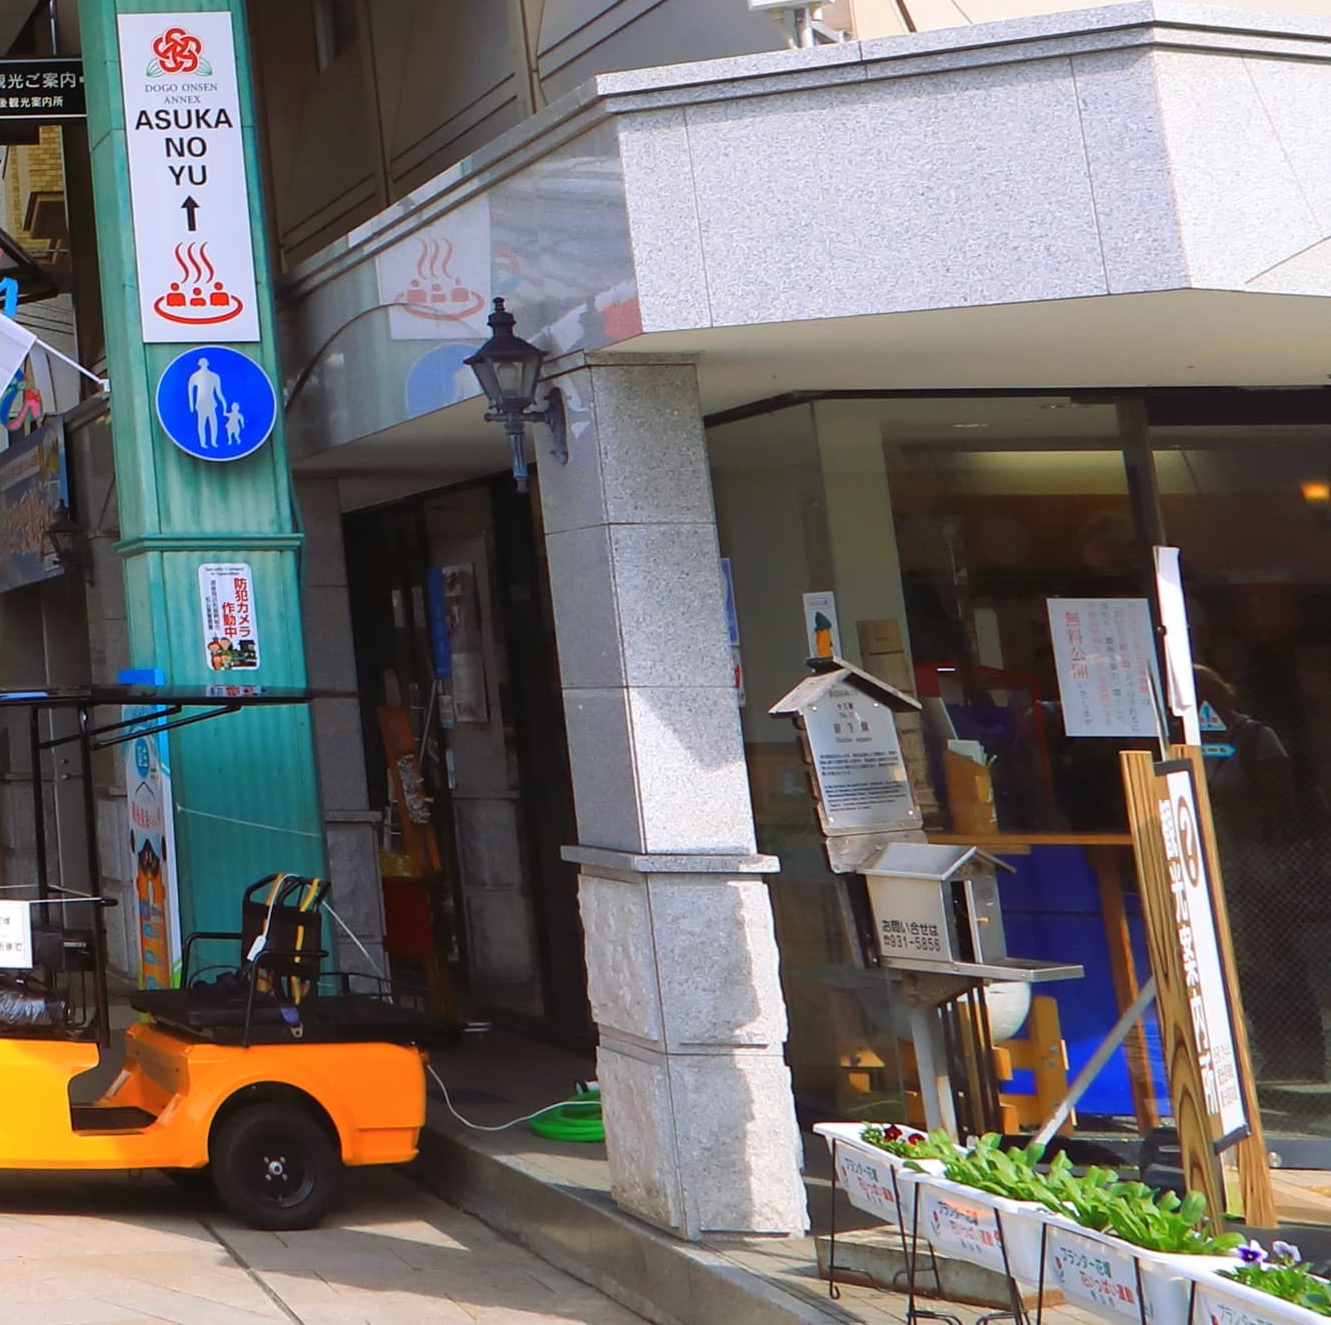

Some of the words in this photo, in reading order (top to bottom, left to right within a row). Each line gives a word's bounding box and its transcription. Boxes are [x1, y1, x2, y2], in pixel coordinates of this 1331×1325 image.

[144, 83, 178, 93] DOGO
[181, 83, 218, 92] ONSEN
[164, 95, 202, 105] ANNEX
[135, 108, 234, 130] ASUKA
[165, 136, 208, 158] NO
[167, 164, 208, 186] YU
[233, 577, 251, 637] 防犯カメラ
[221, 601, 237, 638] 作動中
[881, 919, 939, 937] お問い合せは
